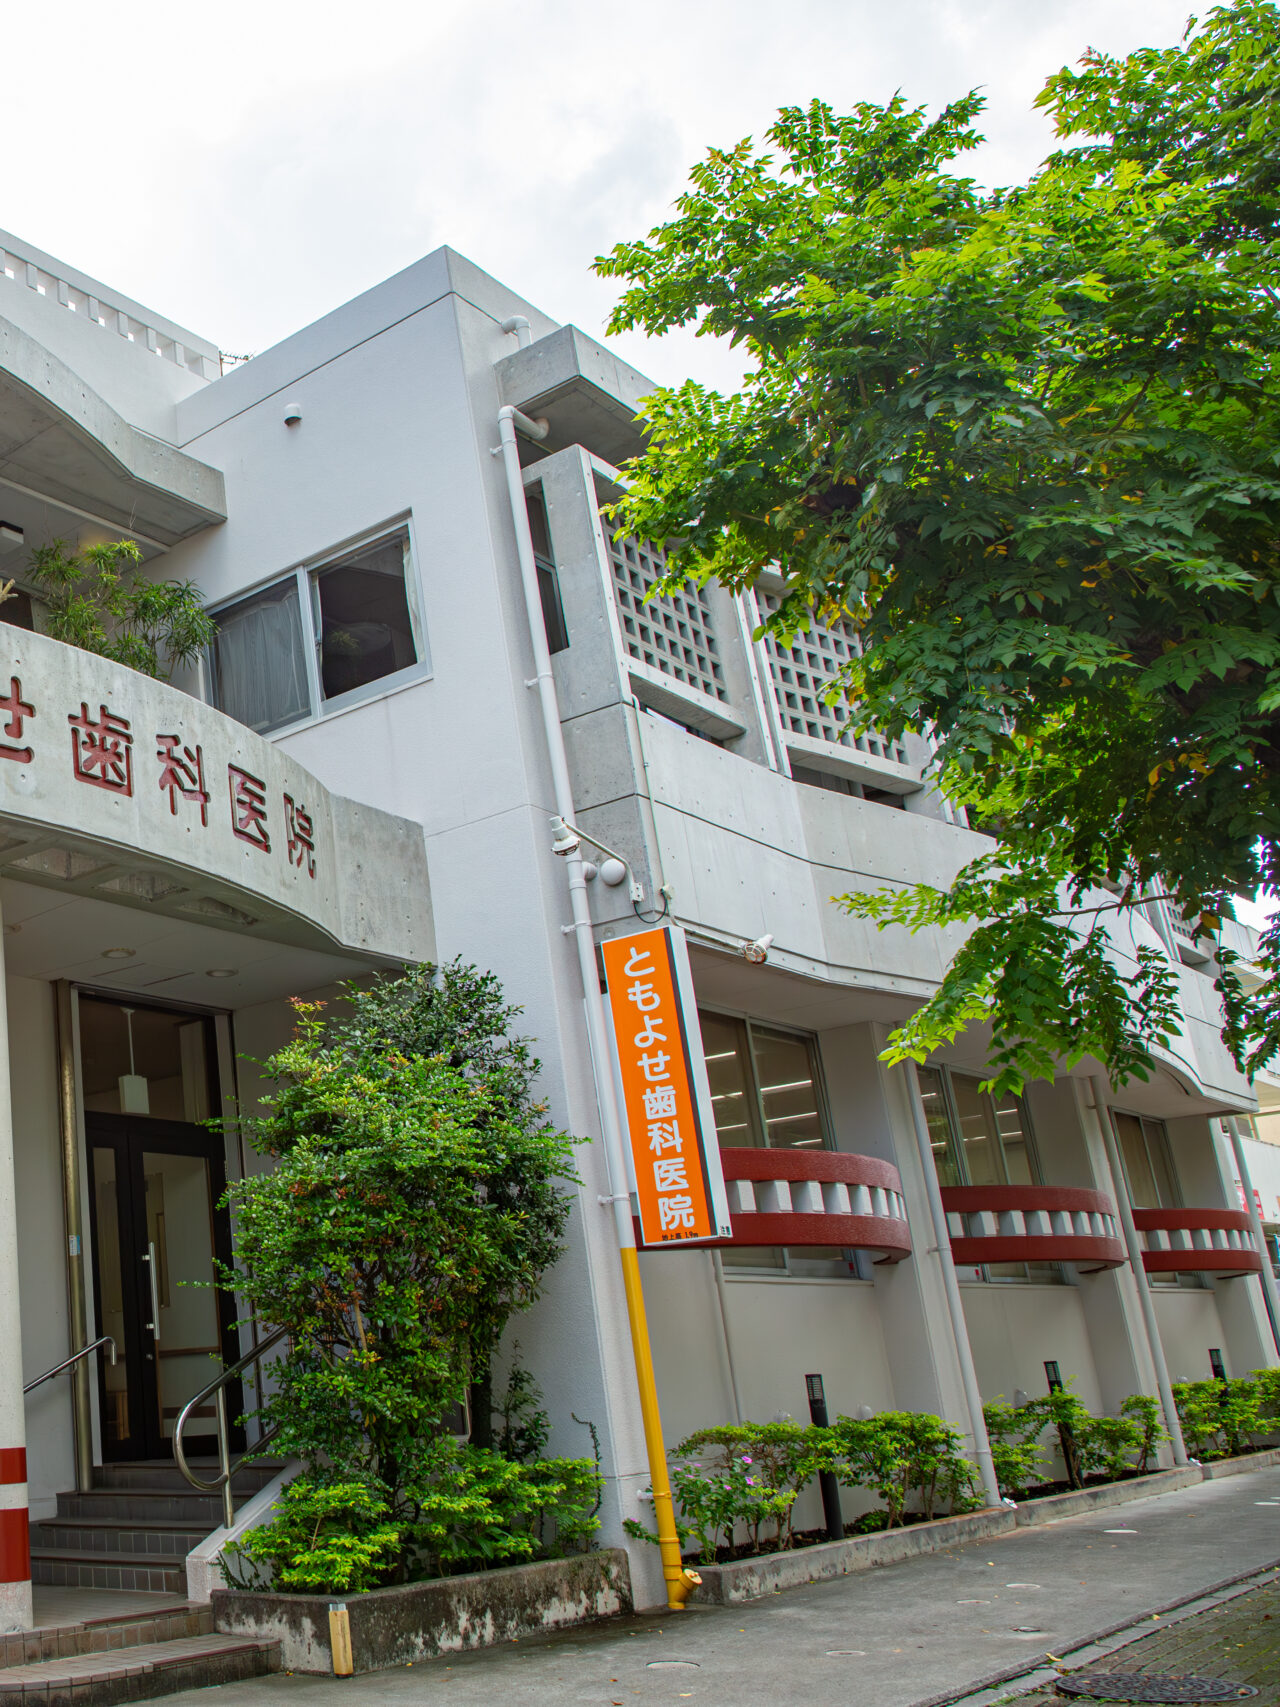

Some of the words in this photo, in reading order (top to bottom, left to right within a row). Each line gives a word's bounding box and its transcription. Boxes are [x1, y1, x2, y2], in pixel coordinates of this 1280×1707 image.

[624, 947, 695, 1231] ともよせ歯科医院
